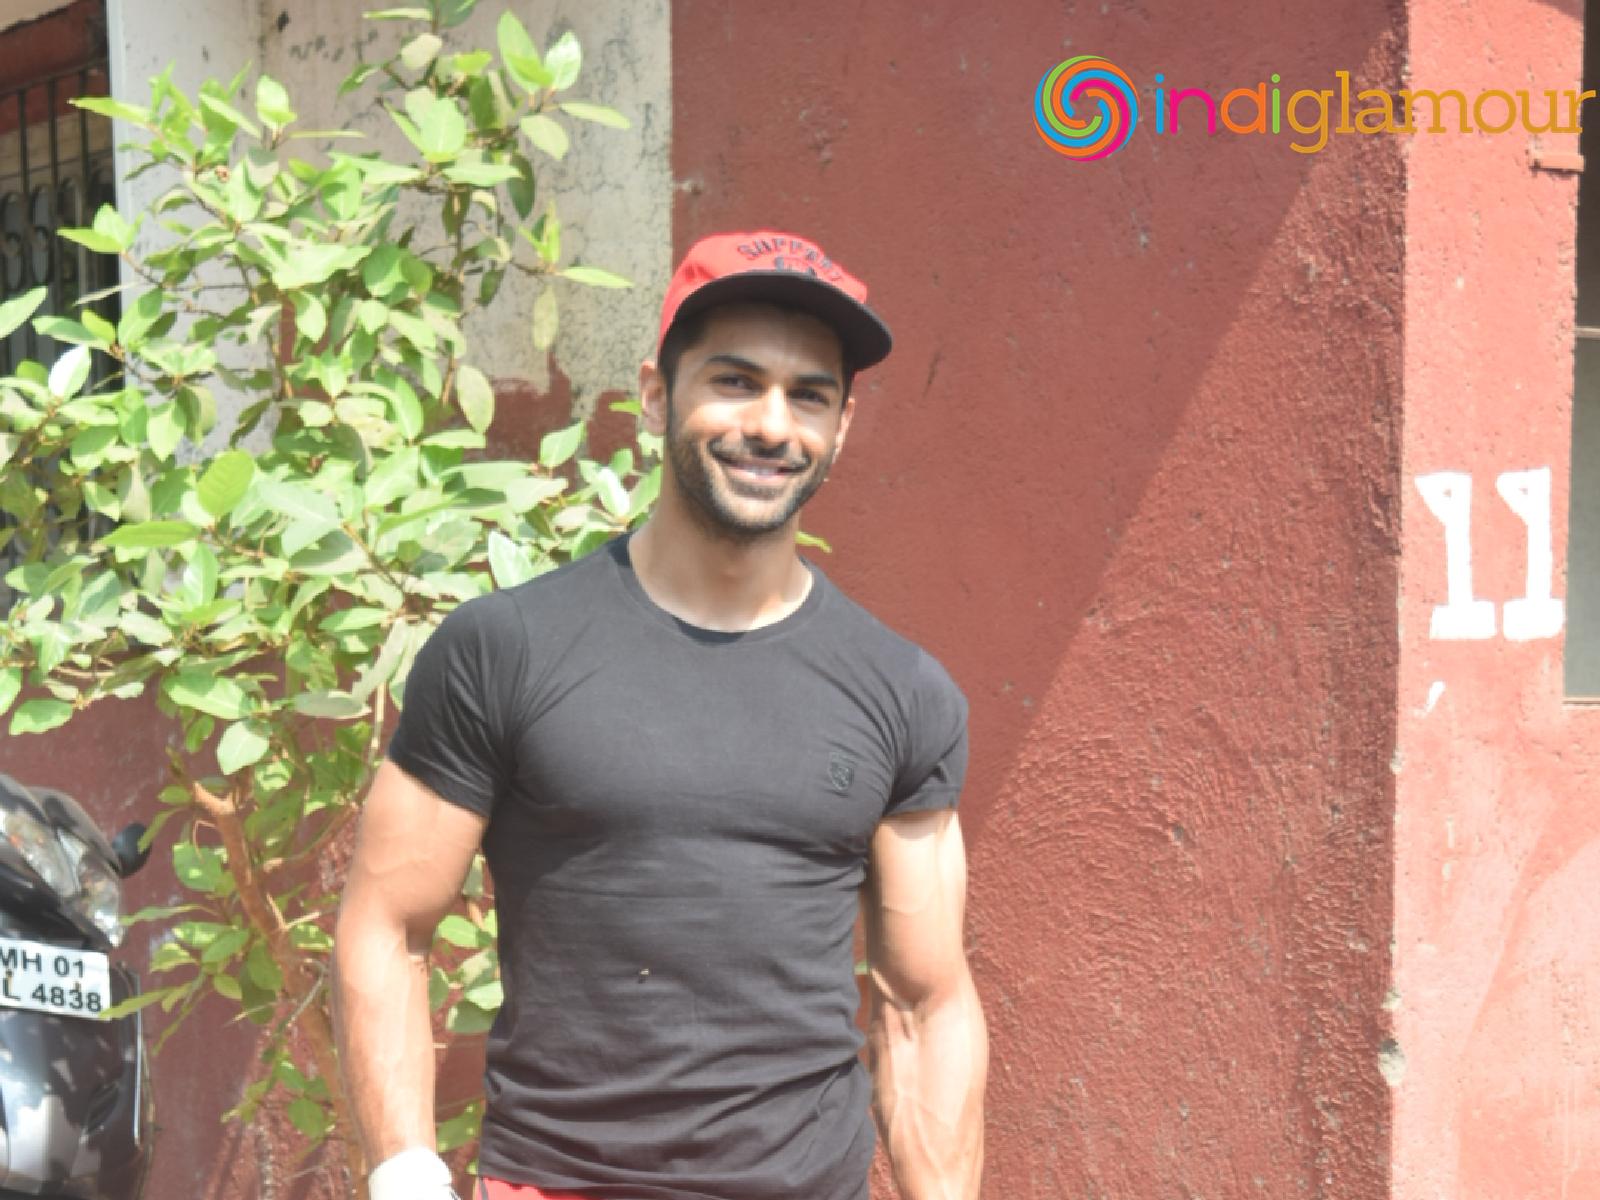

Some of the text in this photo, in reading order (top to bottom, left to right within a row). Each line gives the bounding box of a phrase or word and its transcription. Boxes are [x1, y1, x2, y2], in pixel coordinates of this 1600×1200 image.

[1414, 466, 1564, 642] 11
[0, 946, 85, 979] MH 01
[31, 983, 102, 1013] 4838
